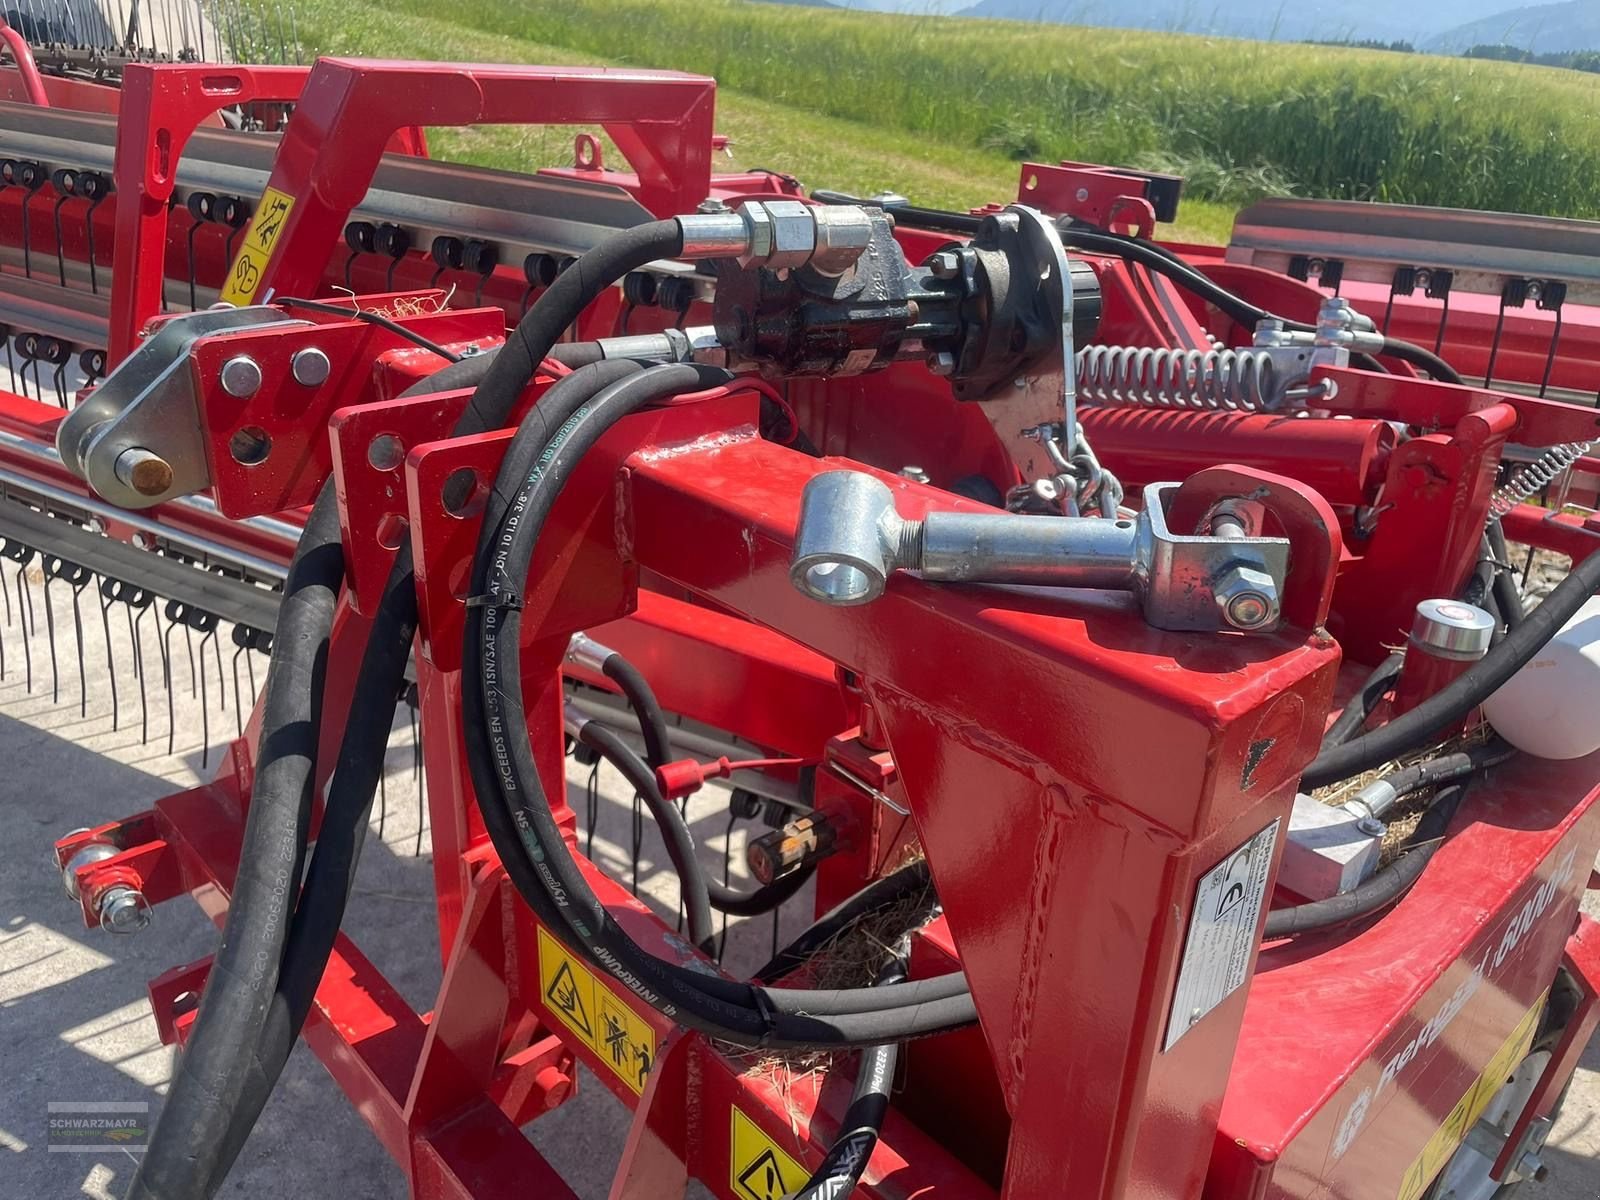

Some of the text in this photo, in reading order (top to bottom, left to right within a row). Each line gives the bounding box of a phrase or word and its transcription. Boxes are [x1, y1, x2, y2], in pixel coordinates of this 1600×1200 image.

[540, 449, 553, 464] 180
[501, 534, 513, 546] 10
[495, 550, 508, 569] DN
[485, 634, 497, 685] 1SN/SAE
[491, 718, 502, 733] EN
[494, 737, 516, 791] EXCEEDS
[538, 863, 569, 907] Hypress
[593, 946, 659, 1004] INTERPUMP
[875, 1050, 887, 1074] 2320
